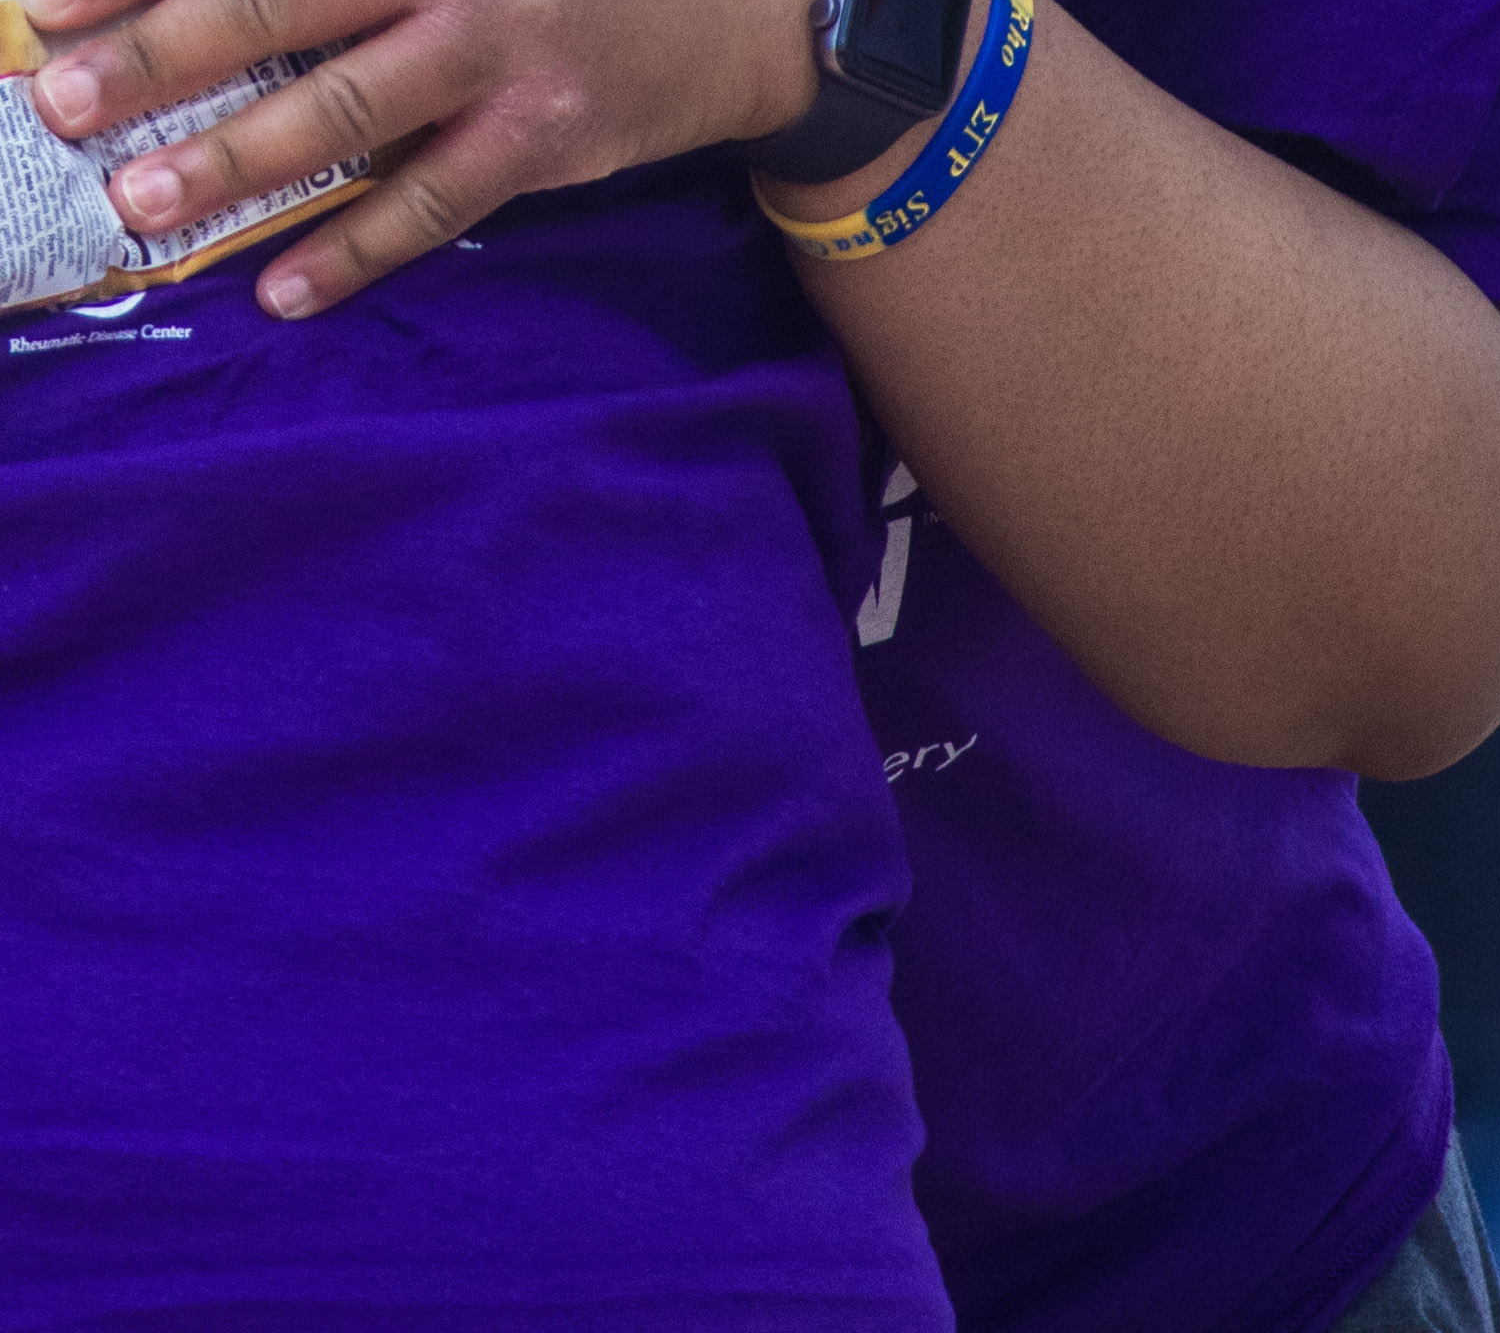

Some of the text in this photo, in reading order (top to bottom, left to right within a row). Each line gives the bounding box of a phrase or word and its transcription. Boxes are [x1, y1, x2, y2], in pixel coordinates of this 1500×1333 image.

[21, 160, 29, 170] or
[23, 171, 35, 191] less
[2, 180, 18, 209] Sauce
[17, 191, 31, 213] Corn
[8, 336, 84, 354] Rheumatic
[139, 323, 193, 339] Center
